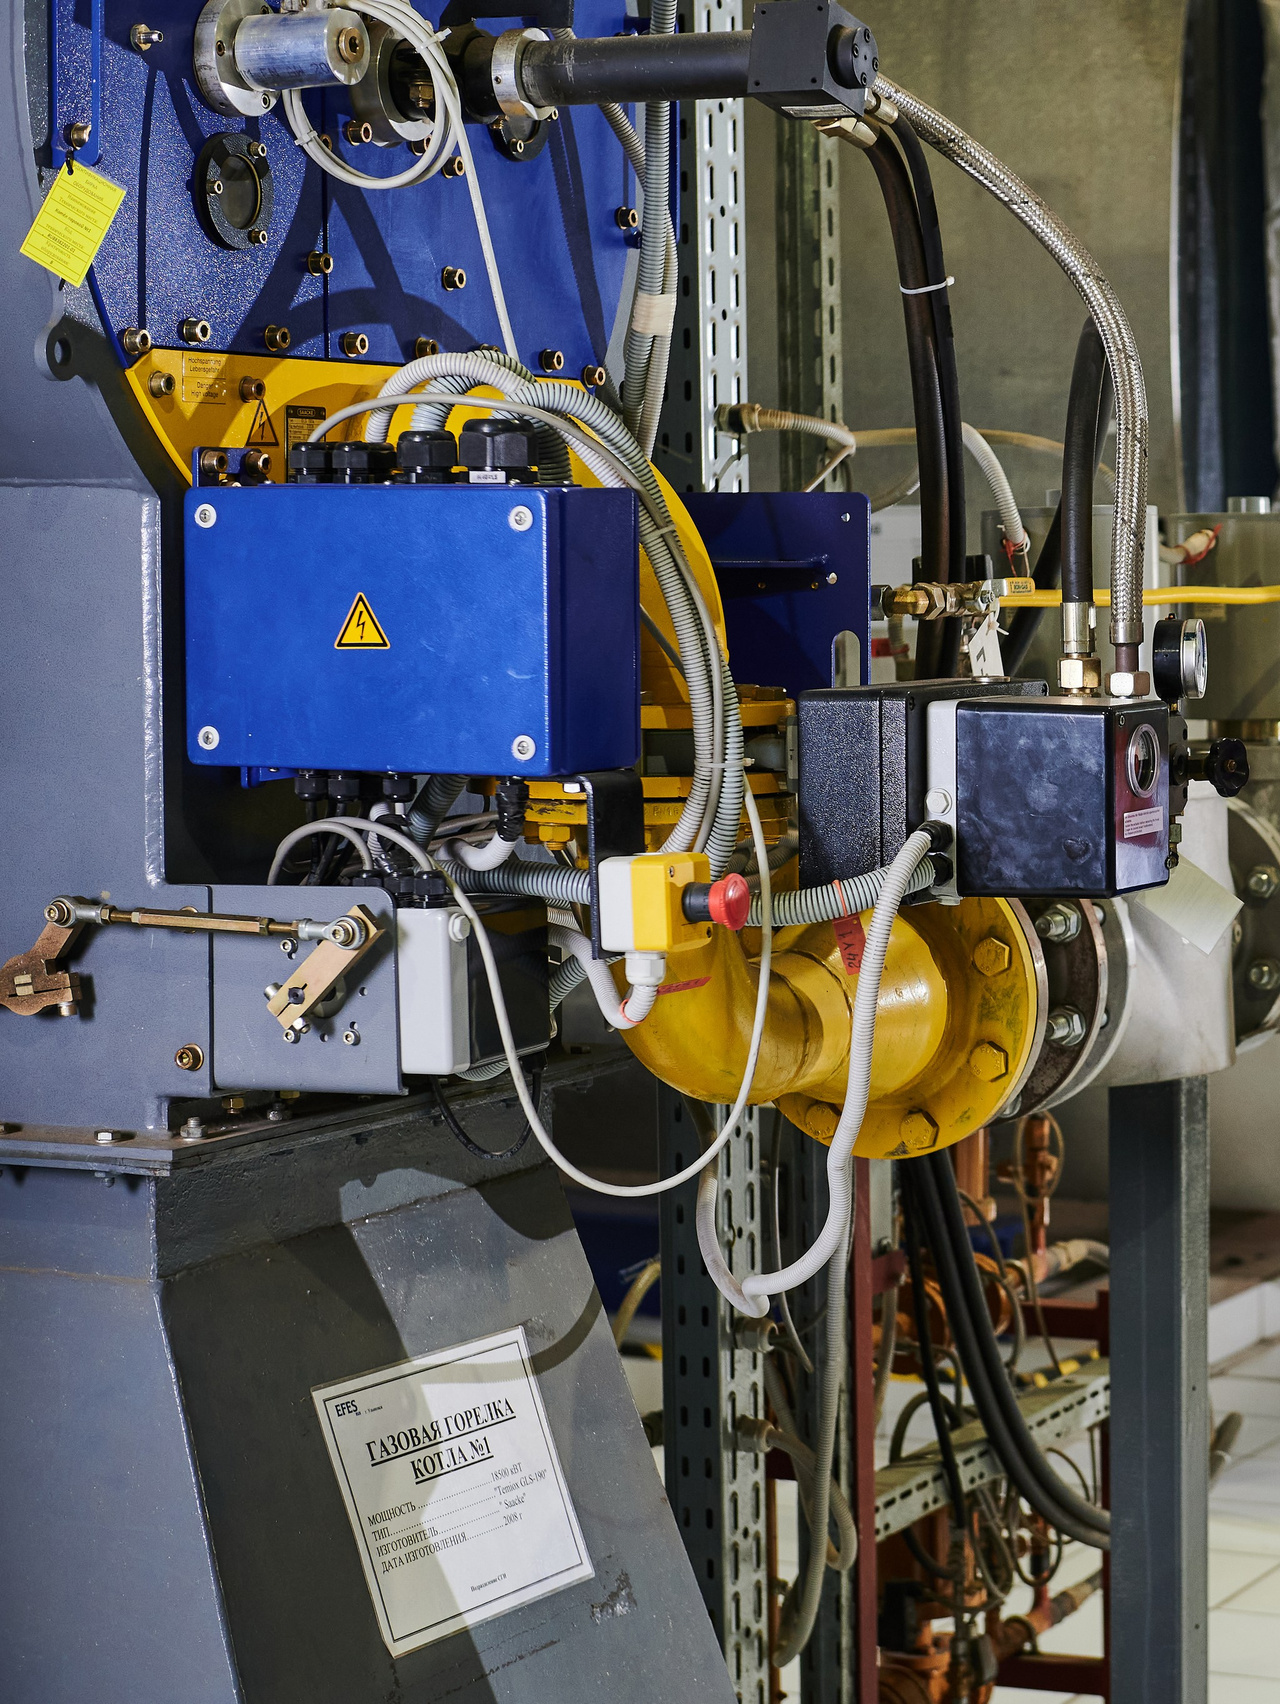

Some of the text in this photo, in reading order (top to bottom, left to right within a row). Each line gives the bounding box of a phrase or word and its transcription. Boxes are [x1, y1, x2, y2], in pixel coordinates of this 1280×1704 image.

[335, 1399, 358, 1417] EFES
[365, 1397, 516, 1462] ГАЗОВАЯ ГОРЕЛКА
[410, 1436, 492, 1480] КОТЛА №1
[367, 1501, 416, 1527] МОЩНОСТЬ
[381, 1555, 405, 1574] ДАТА
[502, 1511, 519, 1526] 2008
